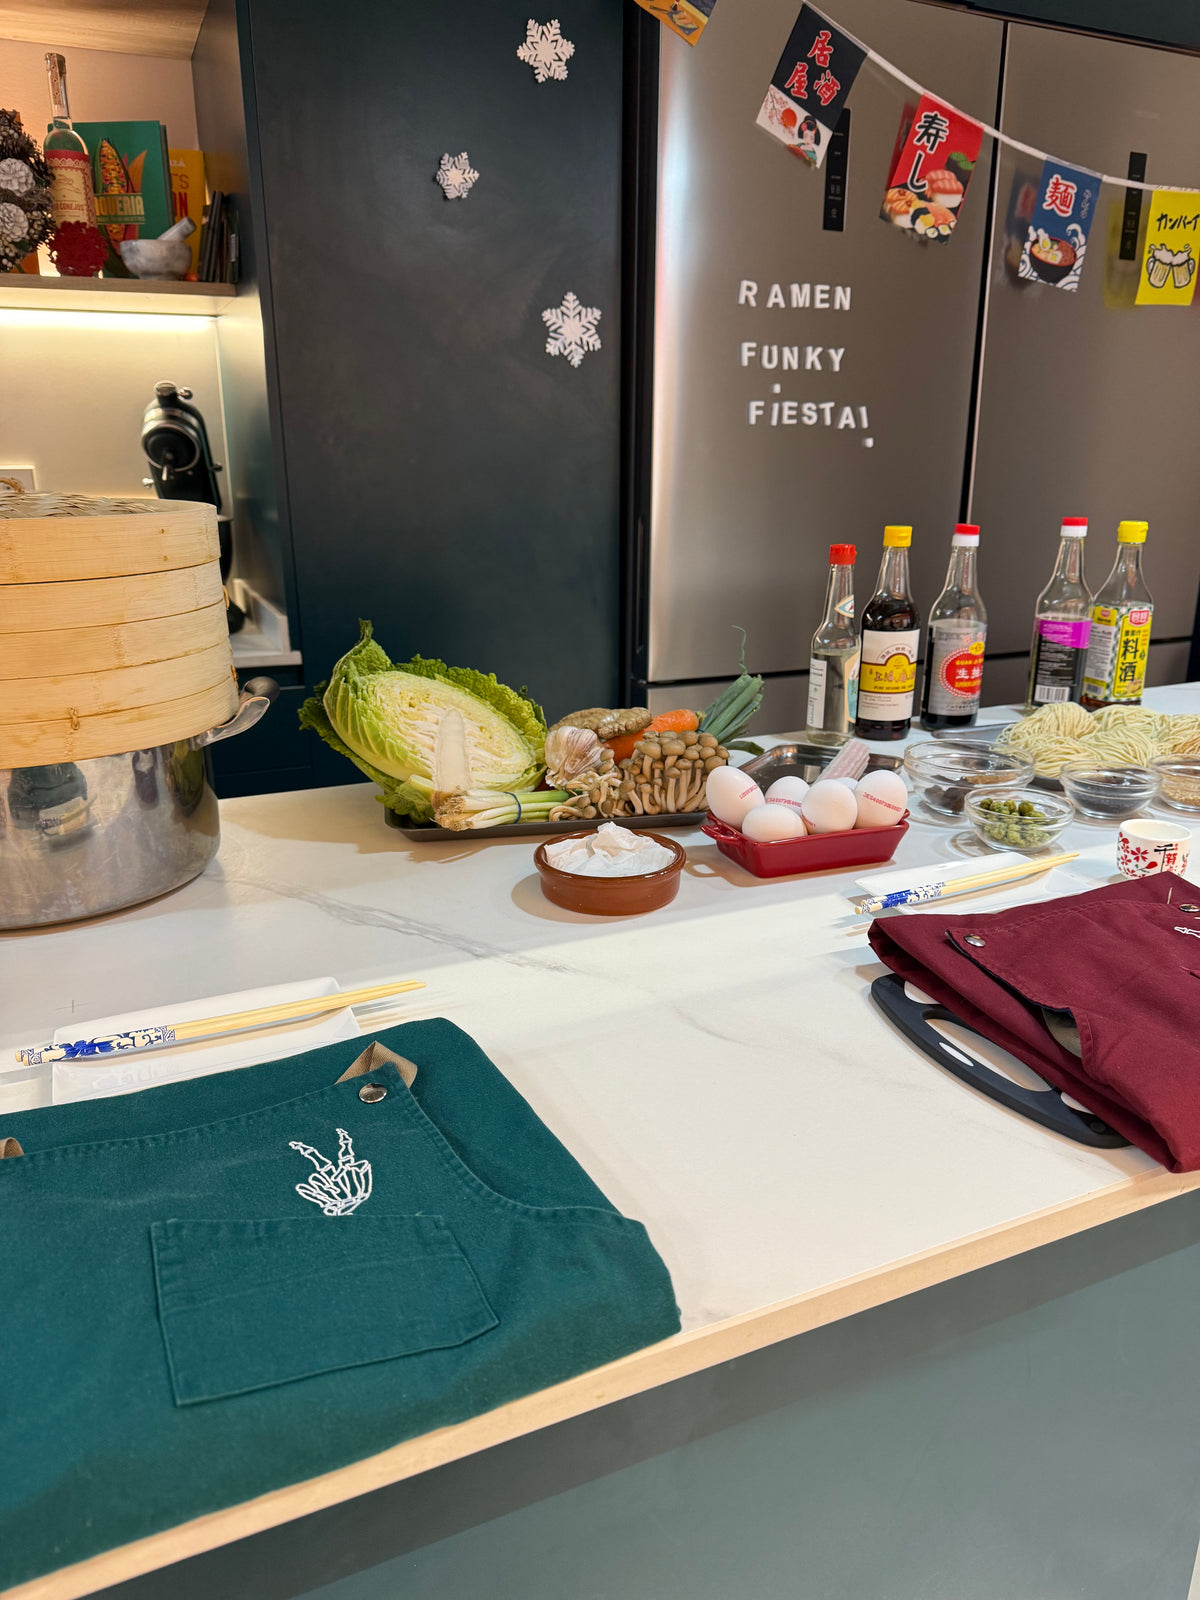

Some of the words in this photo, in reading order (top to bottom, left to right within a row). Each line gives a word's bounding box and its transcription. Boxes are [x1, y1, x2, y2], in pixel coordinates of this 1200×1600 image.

[907, 111, 949, 192] 寿し
[1042, 174, 1077, 217] 麺
[738, 280, 851, 311] RAMEN
[740, 342, 845, 372] FUNKY
[1119, 638, 1139, 682] 料酒
